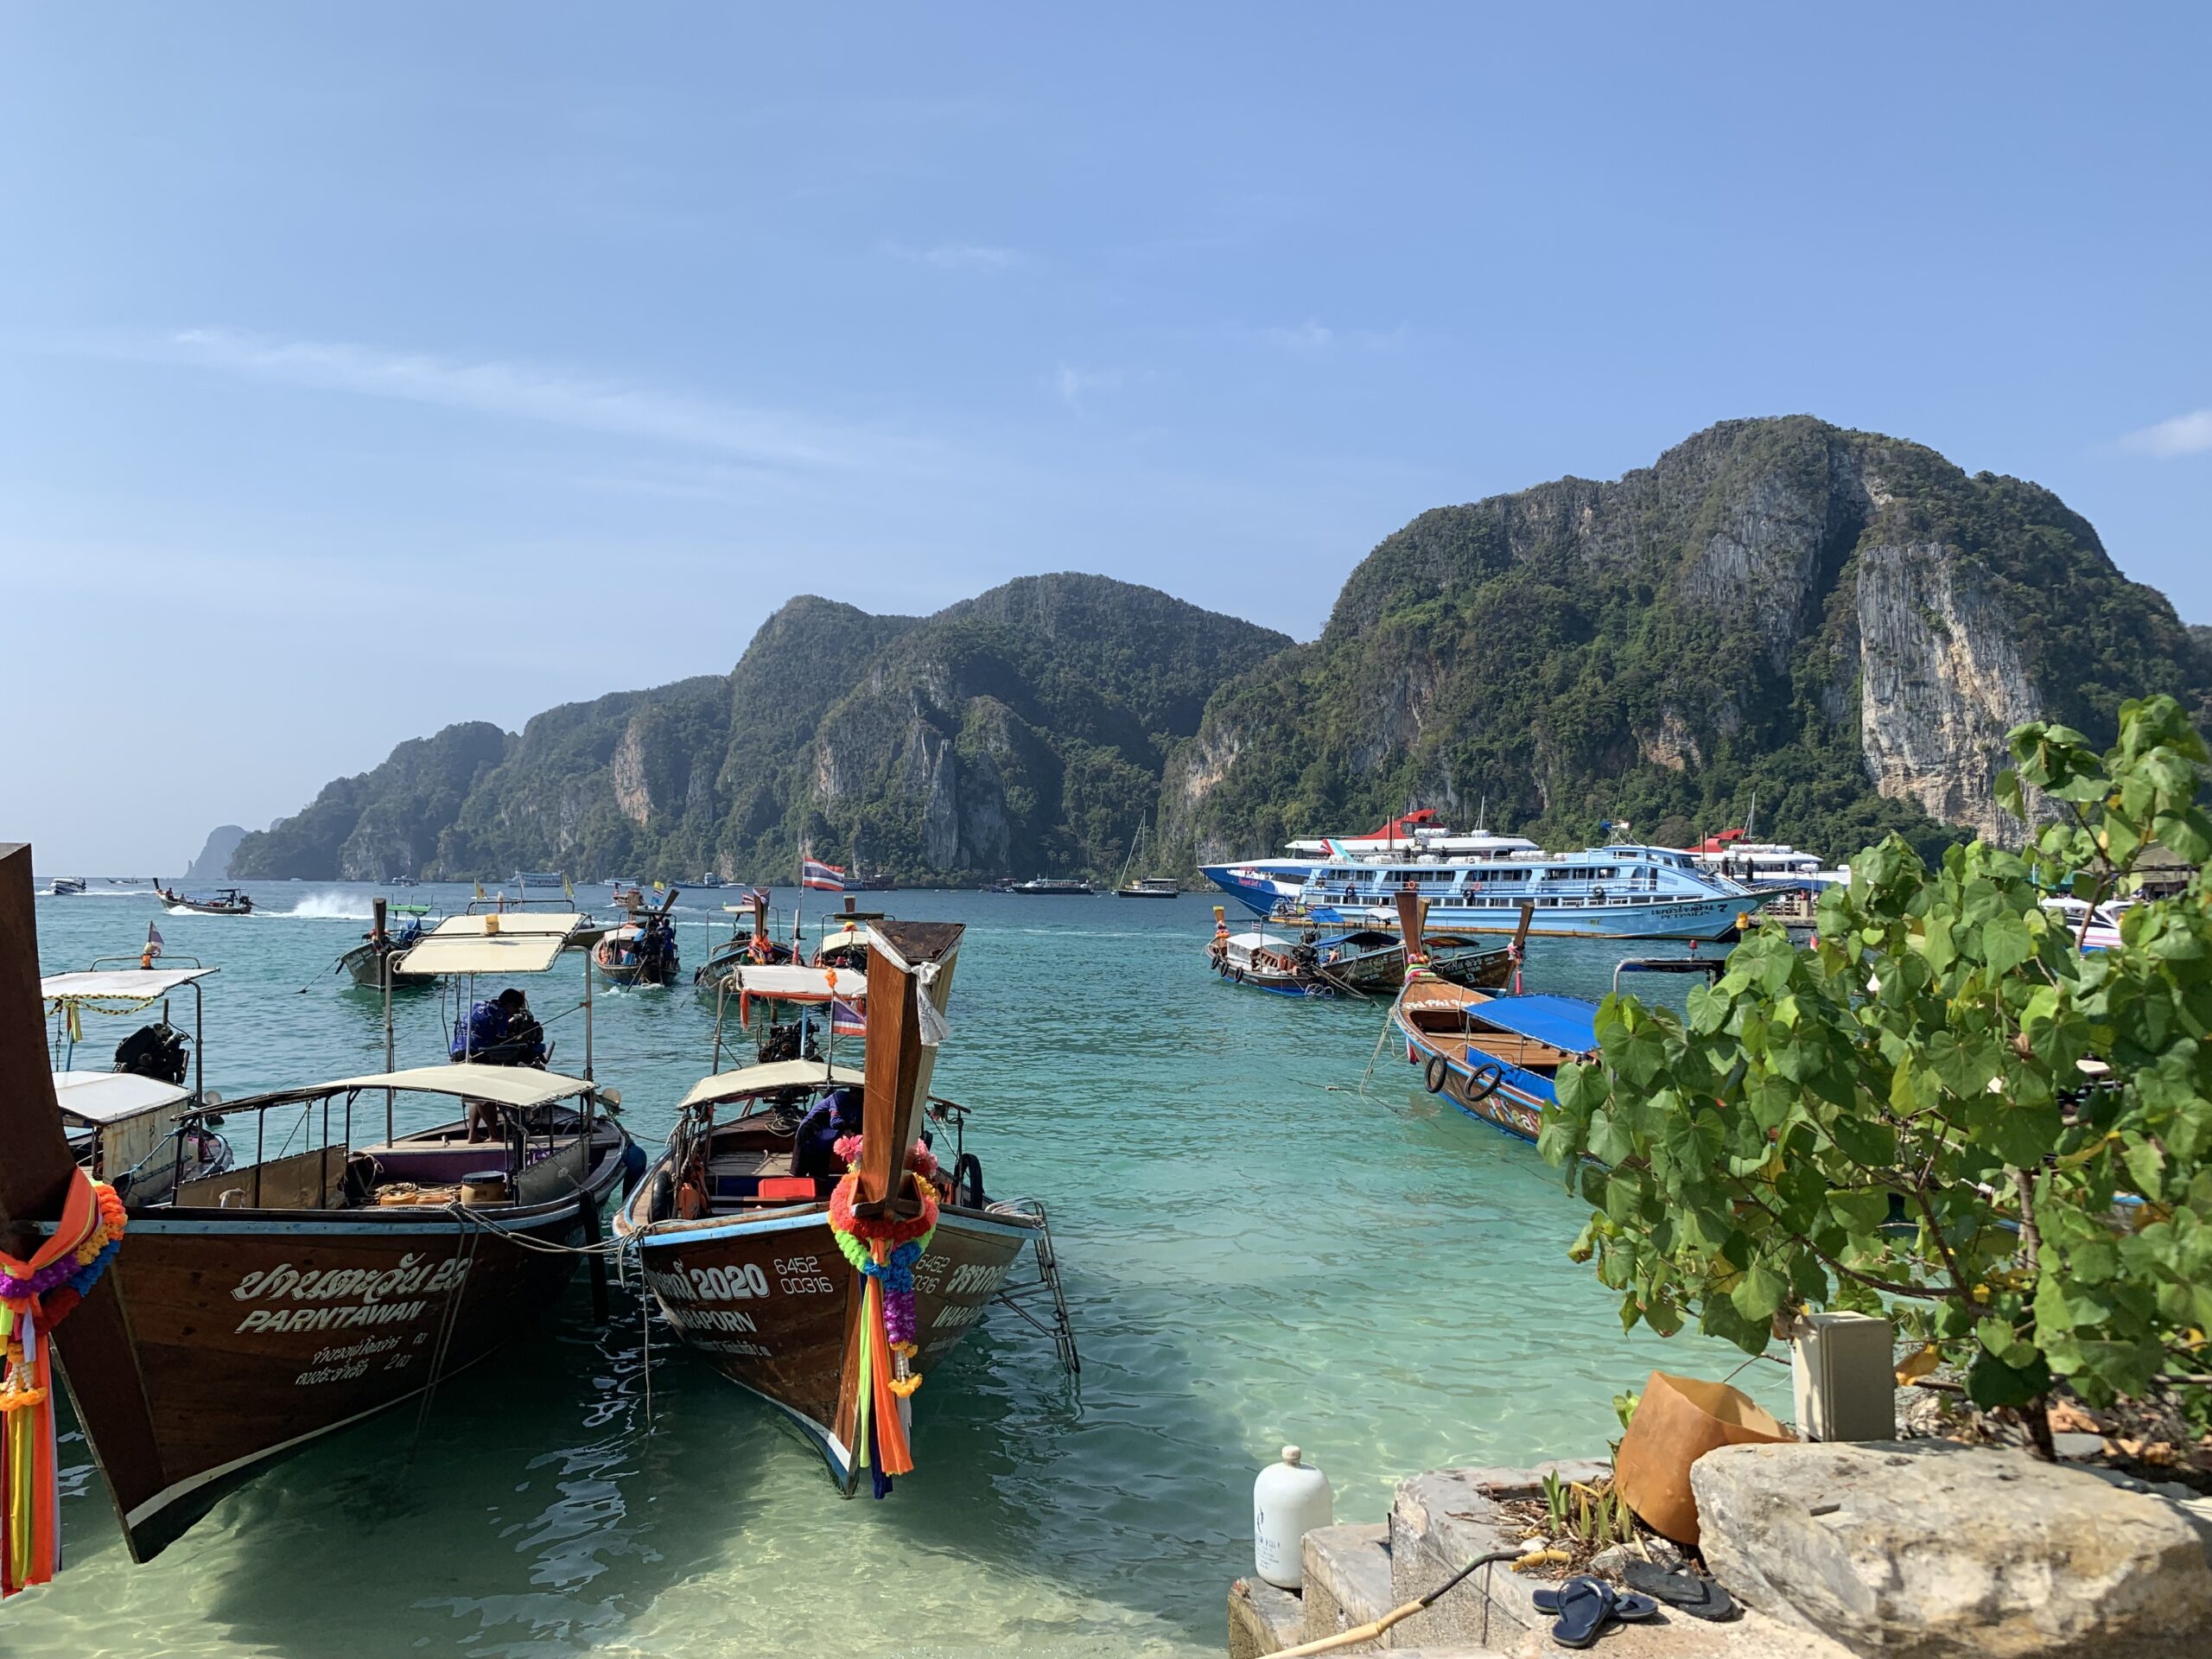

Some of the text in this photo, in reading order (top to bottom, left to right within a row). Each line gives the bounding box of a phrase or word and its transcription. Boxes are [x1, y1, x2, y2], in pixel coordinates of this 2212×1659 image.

[1718, 904, 1728, 912] 7
[1425, 999, 1451, 1008] Phi
[773, 1256, 822, 1274] 6452
[916, 1254, 950, 1273] 6452
[230, 1252, 434, 1305] ปานตะวัน
[690, 1263, 771, 1300] 2020
[780, 1277, 834, 1294] 00316
[233, 1300, 428, 1334] PARNTAWAN
[384, 1353, 400, 1370] 2
